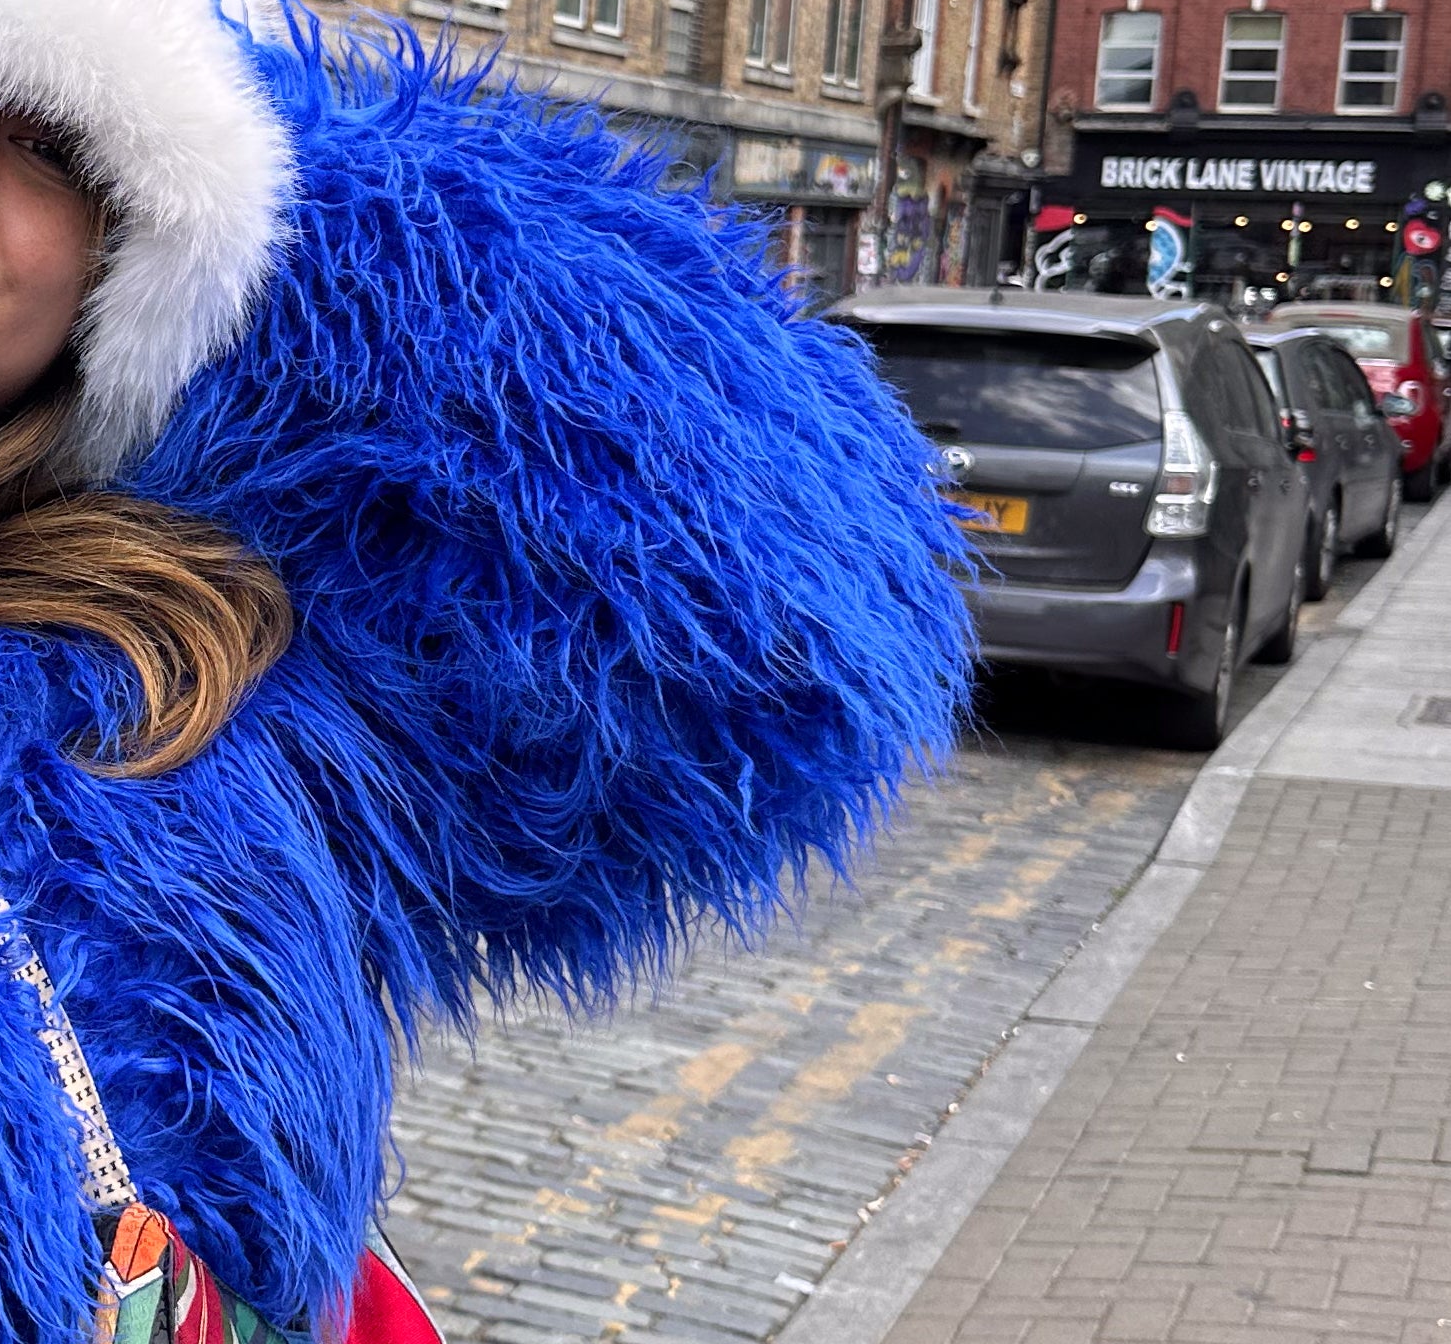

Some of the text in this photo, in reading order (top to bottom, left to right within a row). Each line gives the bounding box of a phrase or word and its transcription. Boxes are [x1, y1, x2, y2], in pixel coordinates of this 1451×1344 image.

[1100, 157, 1376, 193] BRICK LANE VINTAGE
